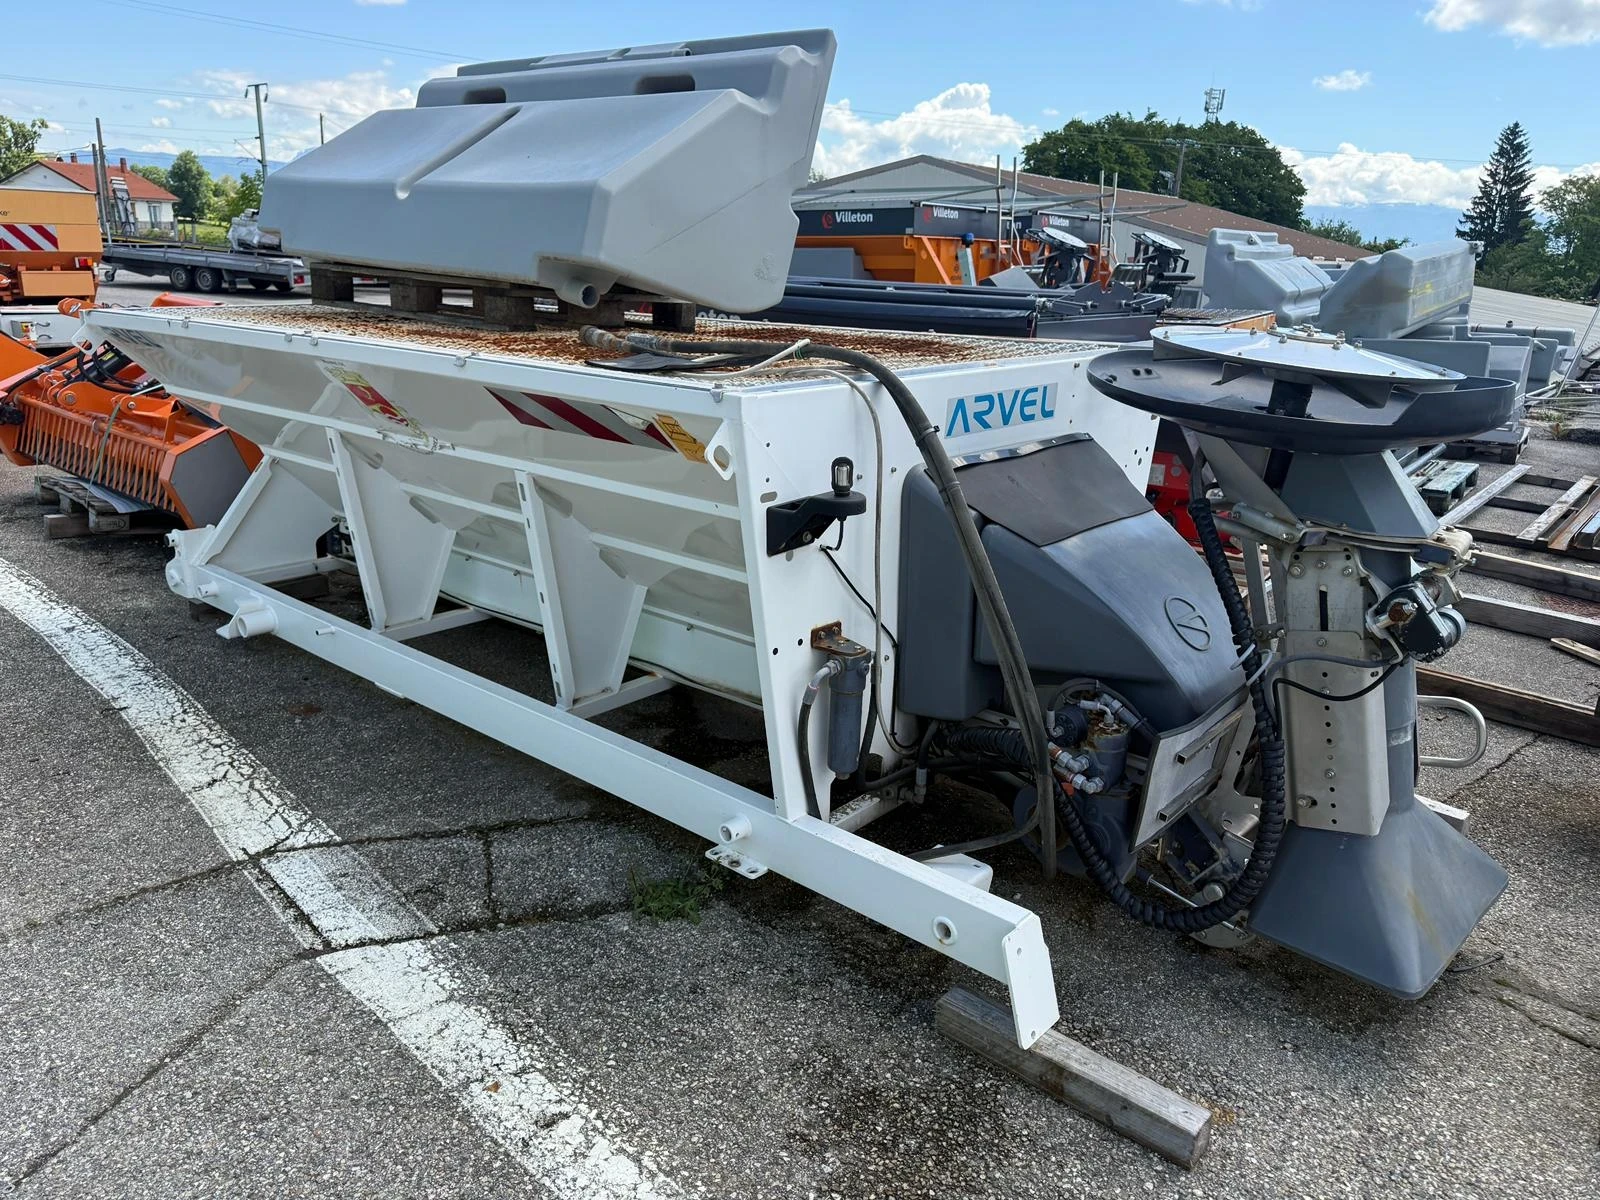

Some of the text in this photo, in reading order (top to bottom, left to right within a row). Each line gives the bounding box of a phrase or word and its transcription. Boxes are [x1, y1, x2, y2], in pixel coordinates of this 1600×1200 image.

[835, 211, 873, 223] Villeton
[932, 206, 959, 219] Villeton
[946, 386, 1055, 437] ARVEL
